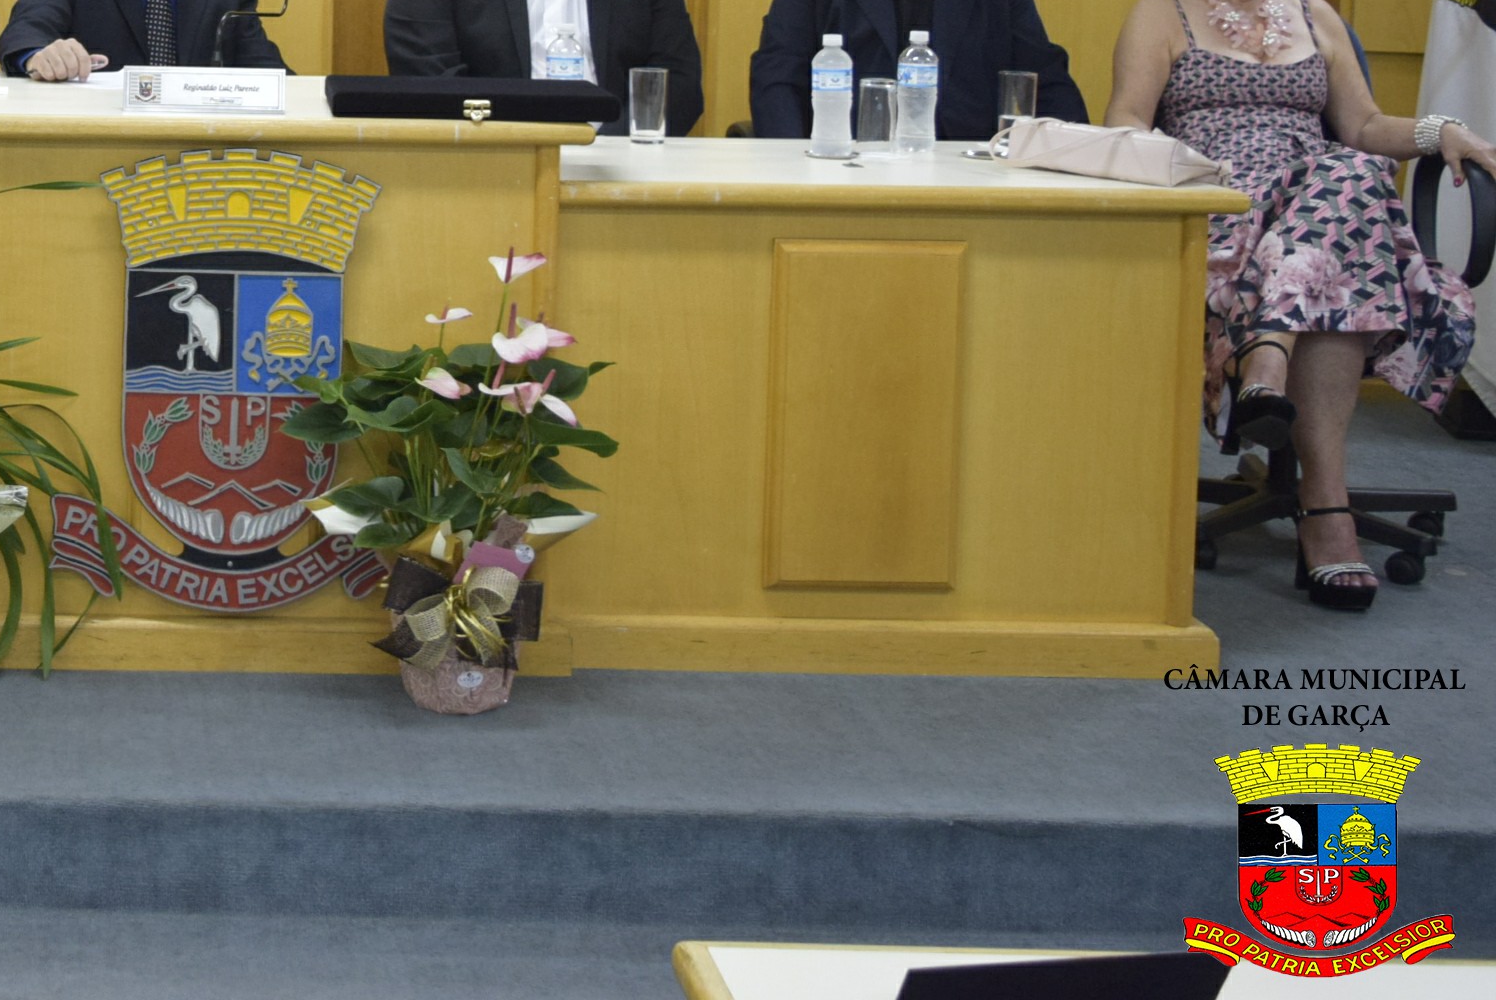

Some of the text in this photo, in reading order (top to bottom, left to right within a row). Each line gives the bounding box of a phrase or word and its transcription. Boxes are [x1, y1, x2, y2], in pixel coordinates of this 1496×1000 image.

[201, 395, 266, 426] S P
[122, 546, 229, 604] PATRIA
[237, 534, 362, 605] EXCELS
